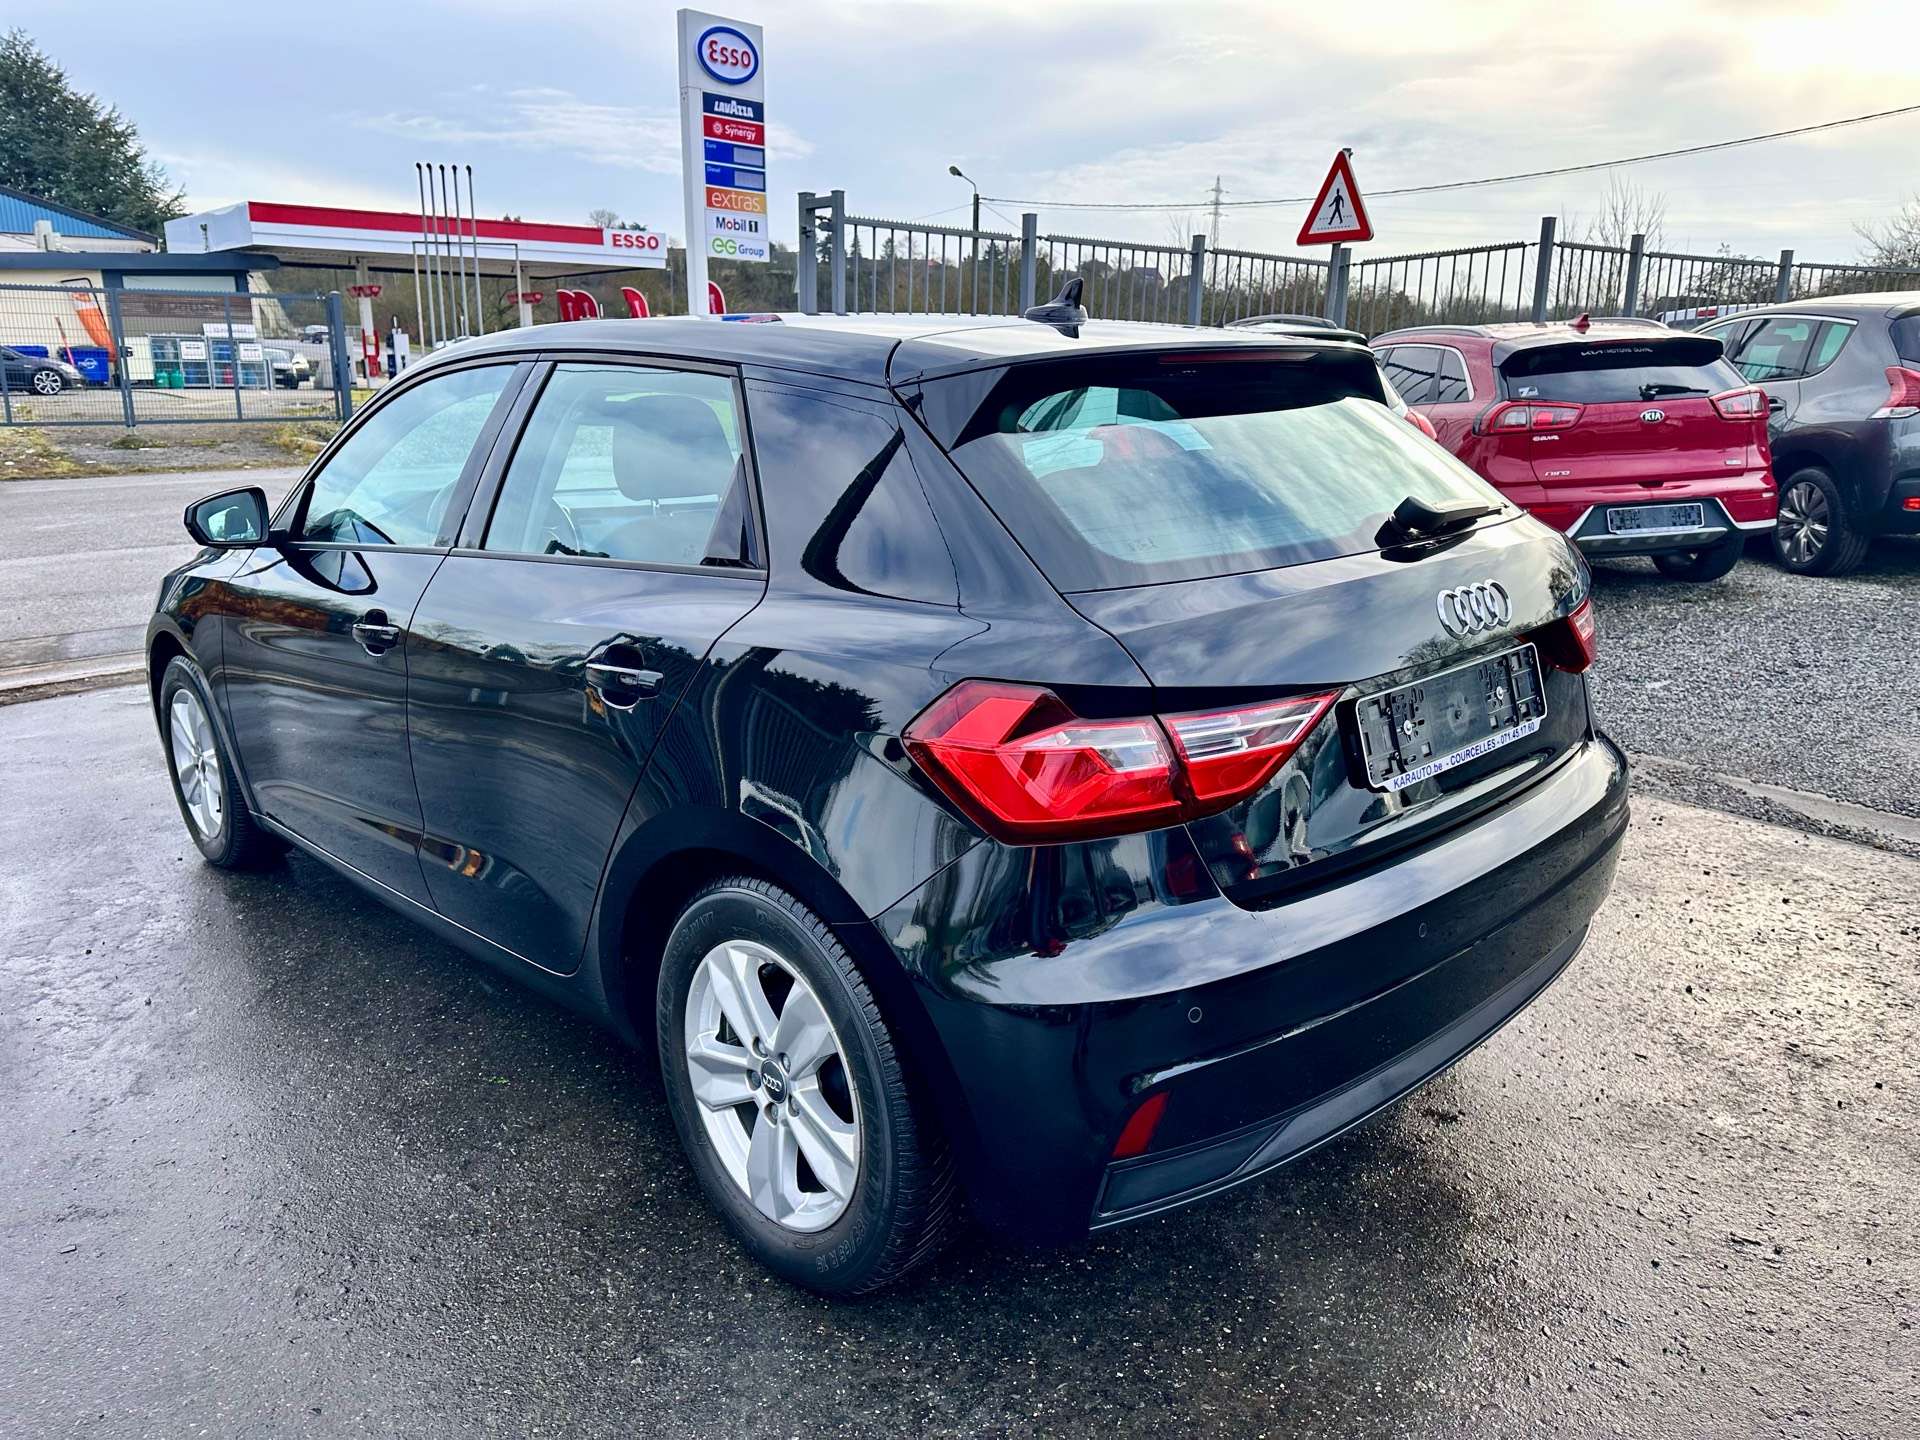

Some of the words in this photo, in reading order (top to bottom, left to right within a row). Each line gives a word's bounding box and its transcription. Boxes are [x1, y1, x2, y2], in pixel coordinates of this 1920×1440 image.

[713, 100, 754, 119] LAVAZZA
[724, 124, 756, 140] Synergy
[711, 191, 761, 212] extras
[715, 216, 747, 232] Mobil
[612, 233, 659, 250] ESSO
[738, 245, 764, 257] Group
[1645, 412, 1661, 421] KIA
[1393, 762, 1443, 790] KARAUTO.be
[1450, 738, 1496, 767] COURCELLES
